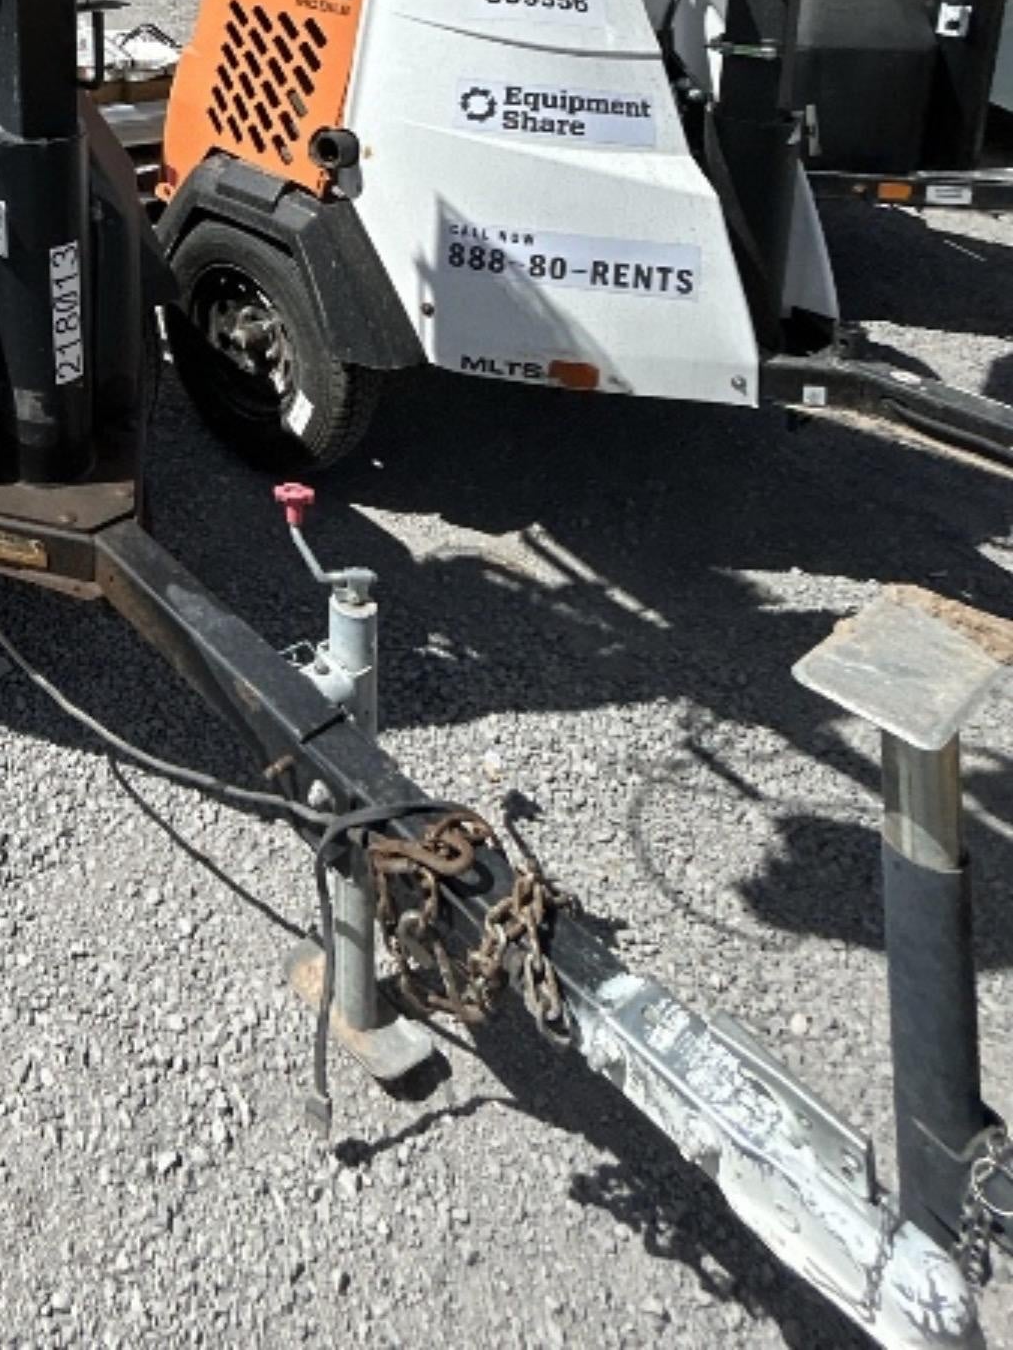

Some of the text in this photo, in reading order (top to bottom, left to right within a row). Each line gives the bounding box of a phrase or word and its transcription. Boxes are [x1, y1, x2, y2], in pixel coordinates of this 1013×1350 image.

[503, 85, 652, 118] Equipment
[502, 110, 586, 137] Share
[448, 241, 695, 295] 888-80-RENTS
